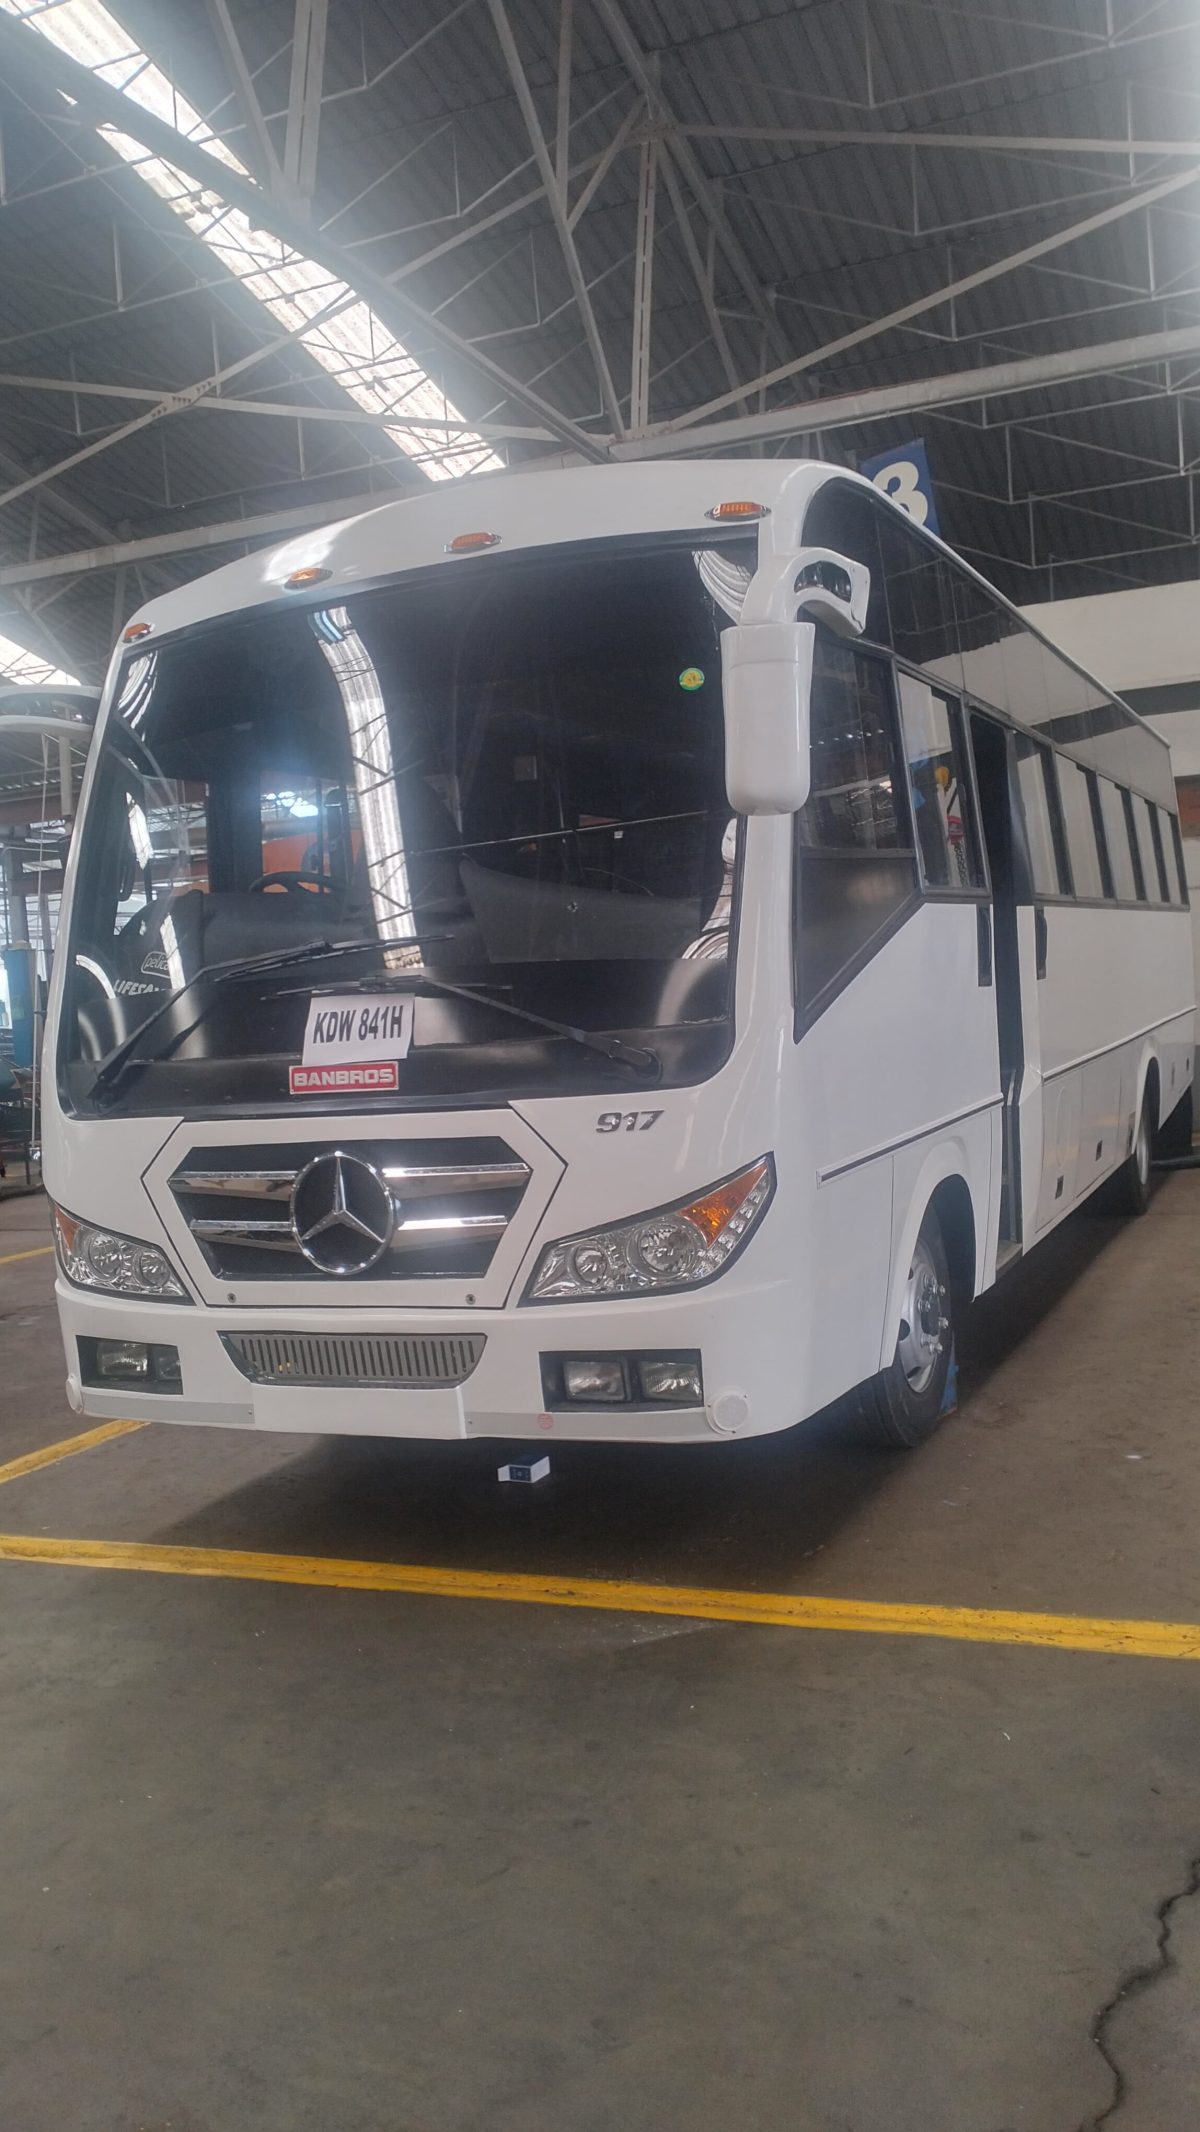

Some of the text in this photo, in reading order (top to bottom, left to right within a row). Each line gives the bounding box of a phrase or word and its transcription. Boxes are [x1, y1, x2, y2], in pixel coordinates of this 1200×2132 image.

[143, 954, 169, 970] pelica
[113, 979, 166, 996] LIFESA
[313, 1005, 404, 1044] KDW 841H
[293, 1068, 395, 1087] BANBROS
[596, 1110, 664, 1133] 917
